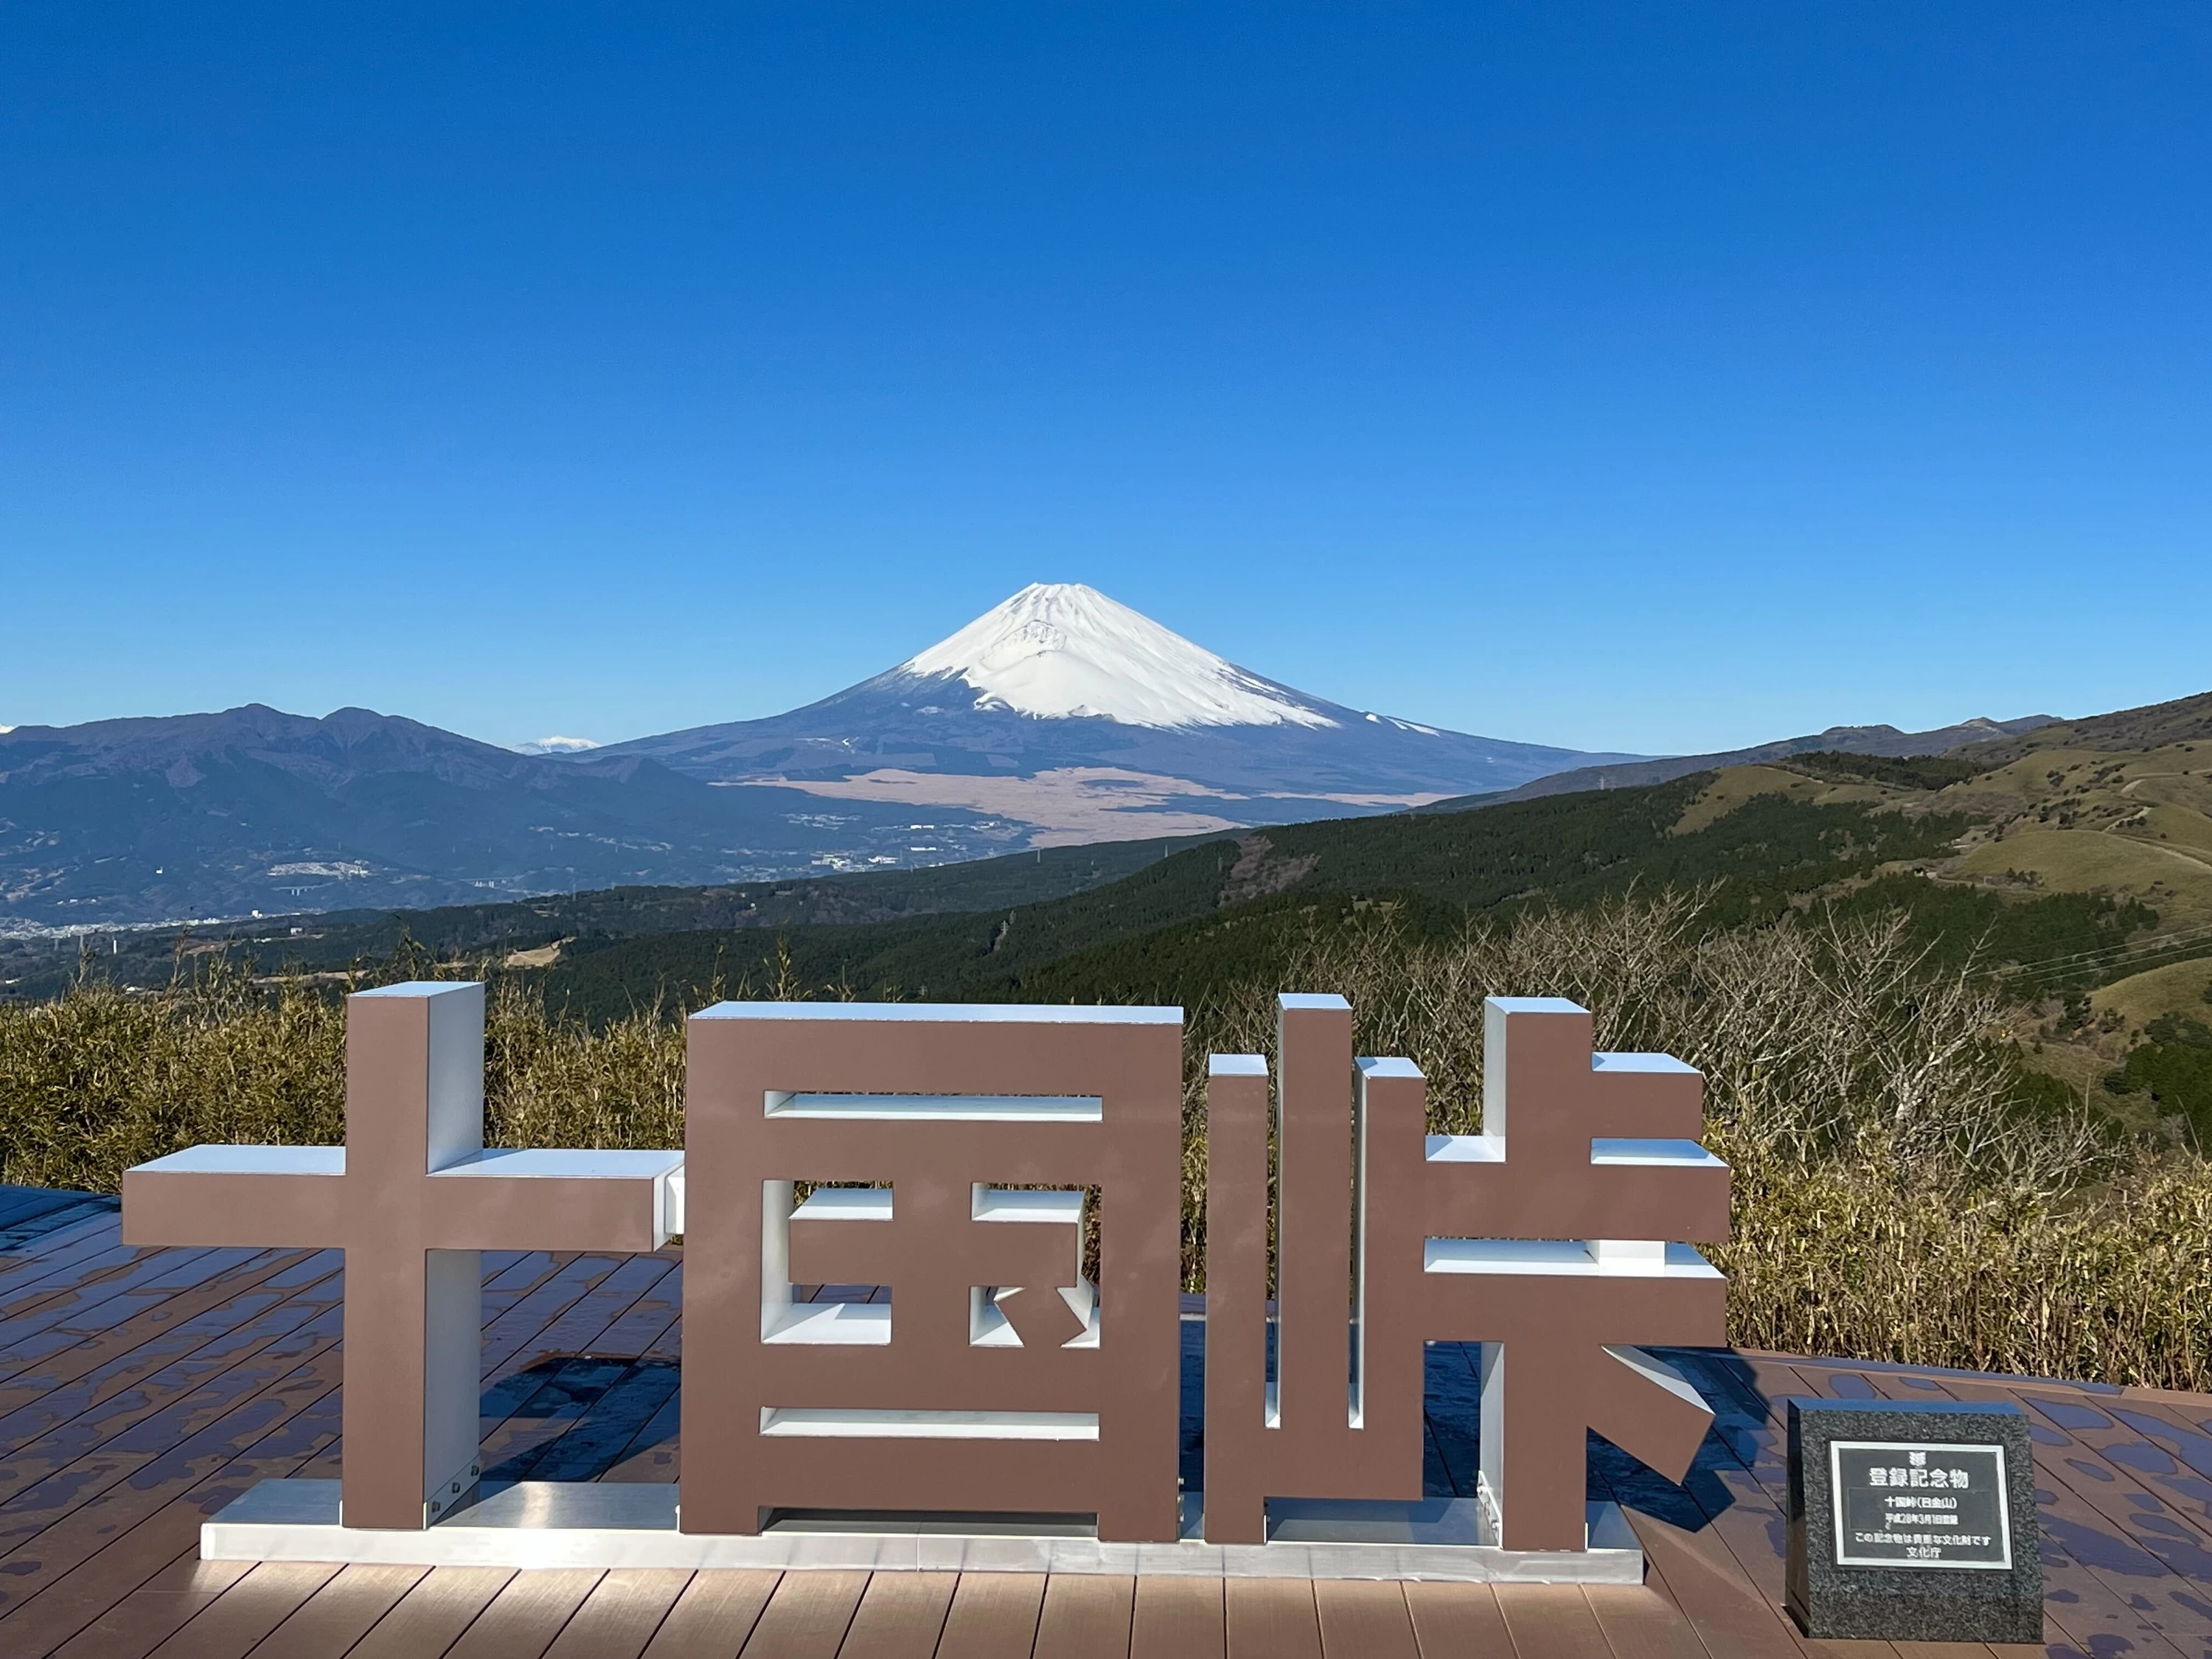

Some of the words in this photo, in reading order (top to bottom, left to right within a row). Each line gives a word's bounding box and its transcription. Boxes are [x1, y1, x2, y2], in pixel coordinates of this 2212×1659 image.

[122, 987, 1730, 1551] 十国峠
[1868, 1467, 1969, 1489] 登録記念物
[1906, 1546, 1942, 1559] 文化庁
